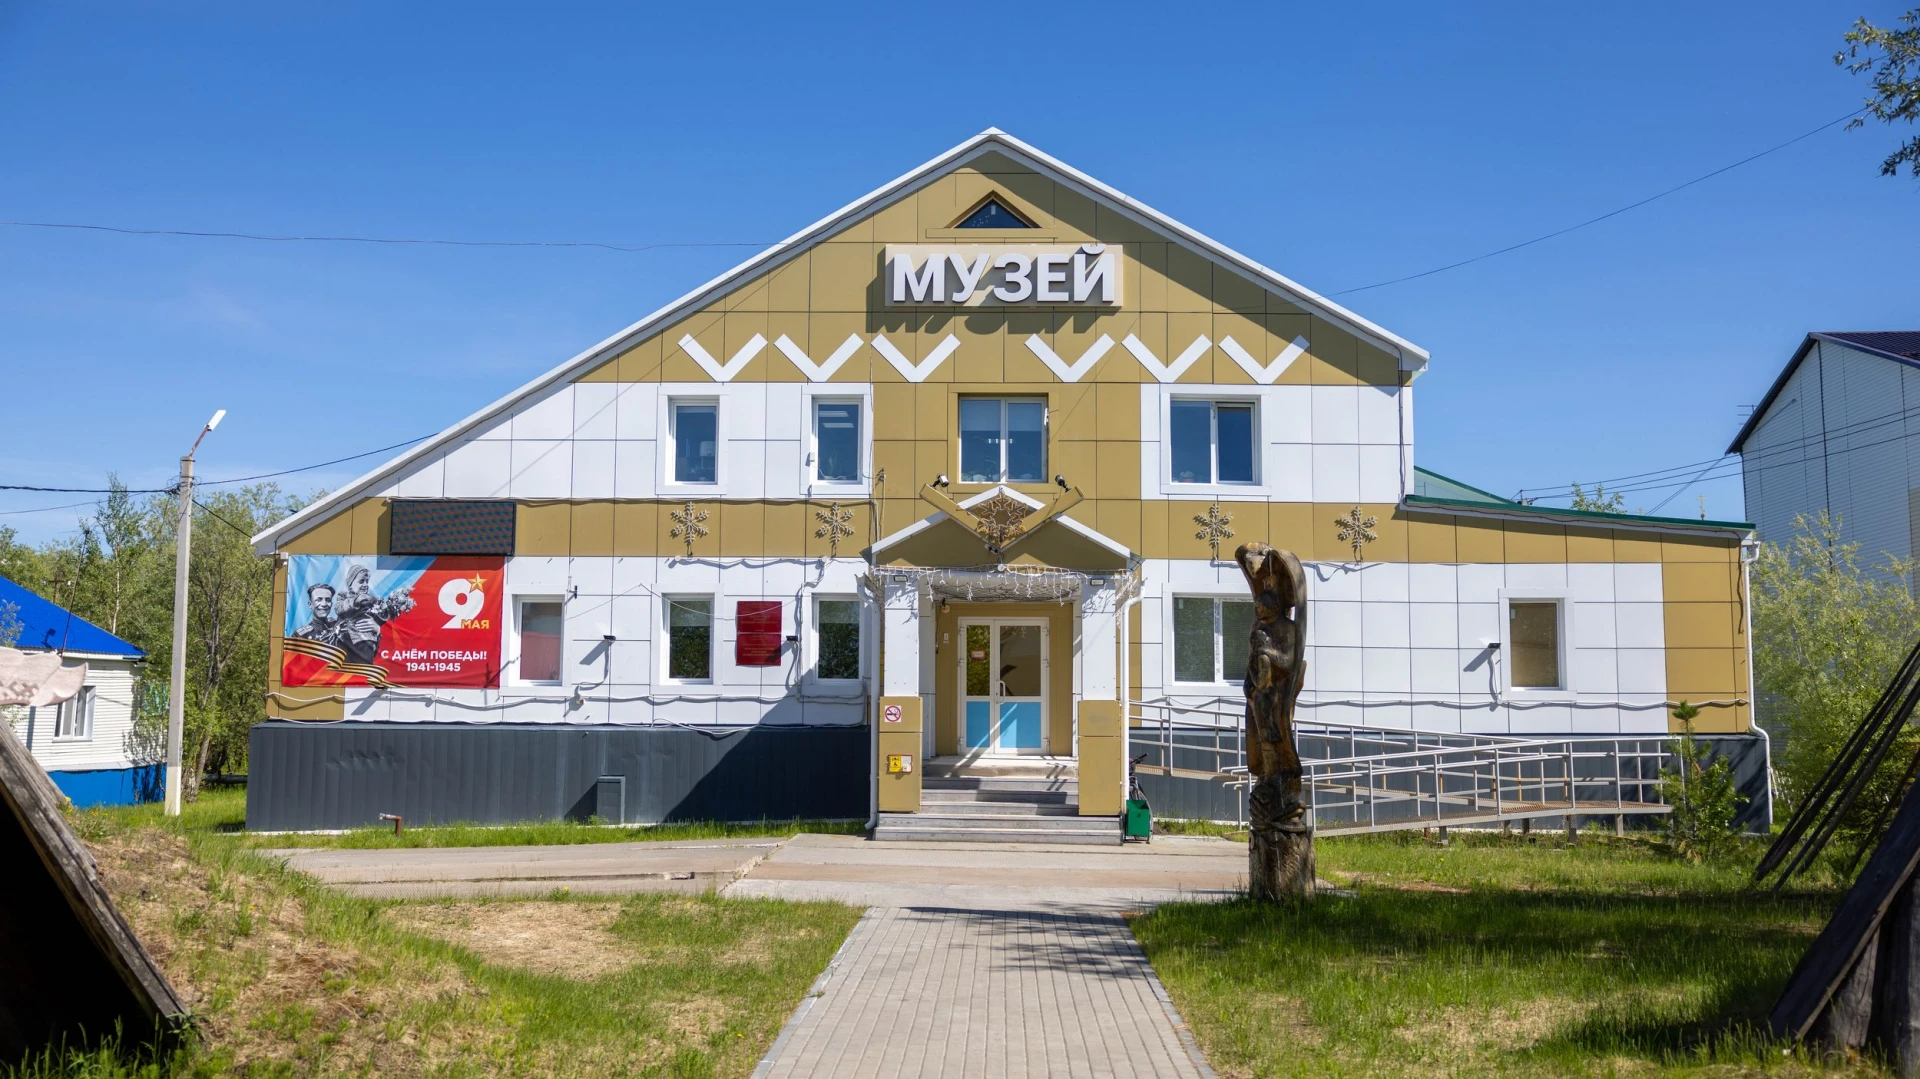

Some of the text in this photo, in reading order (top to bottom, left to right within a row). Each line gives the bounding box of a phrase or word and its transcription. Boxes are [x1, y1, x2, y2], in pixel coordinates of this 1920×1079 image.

[893, 243, 1115, 303] МУЗЕЙ
[438, 578, 489, 630] 9 МАЯ
[380, 648, 487, 661] С ДНЁМ ПОБЕДЫ!
[406, 662, 461, 673] 1941-1945
